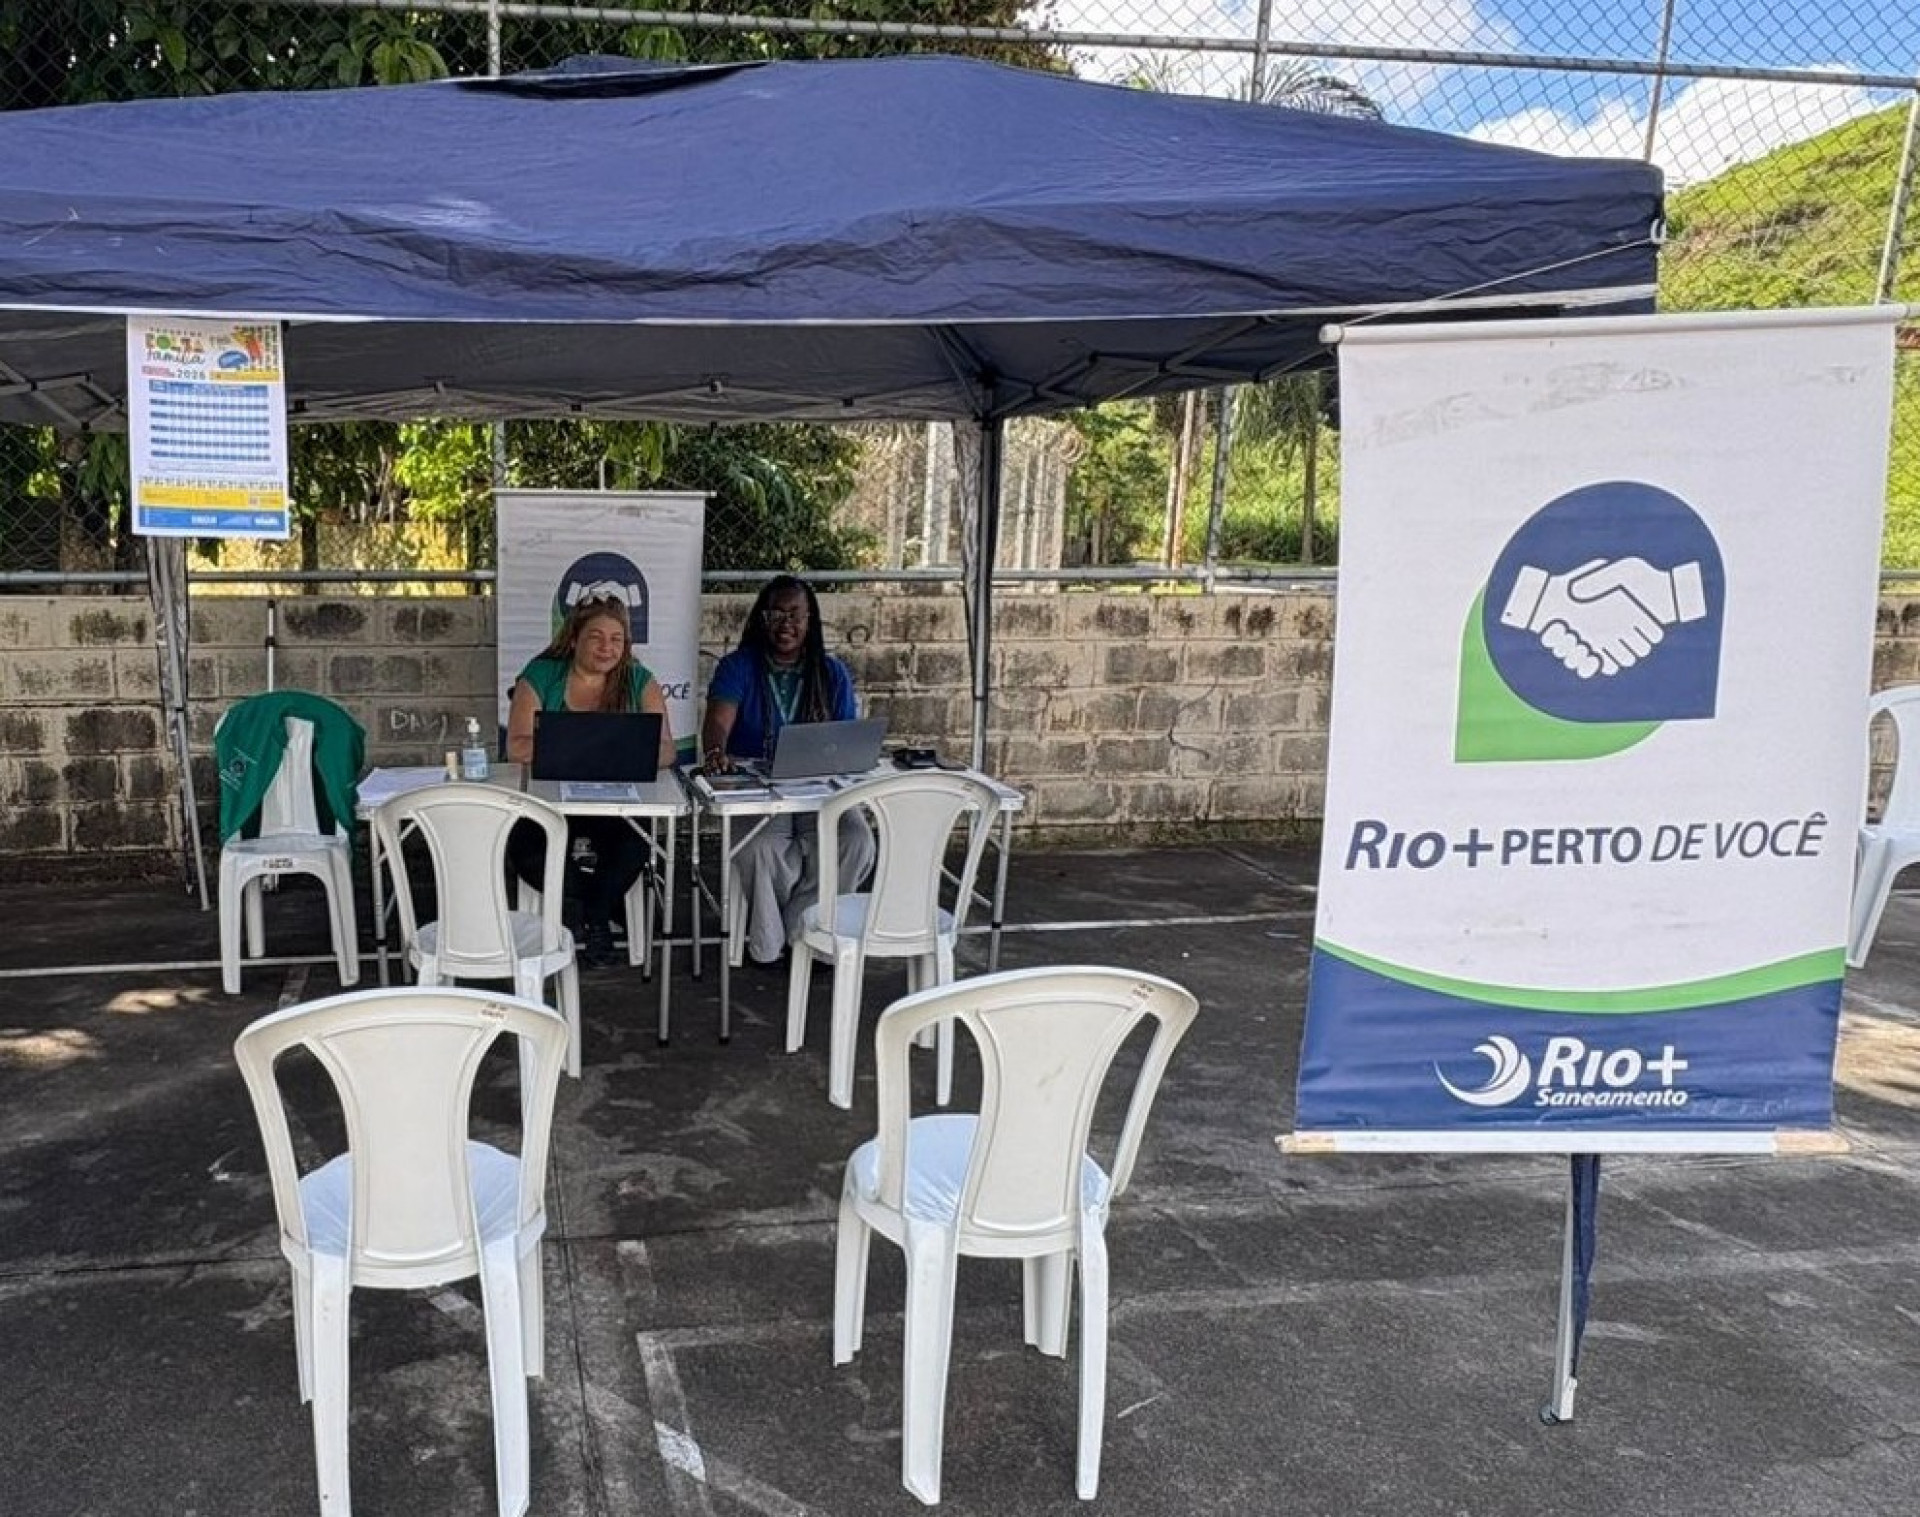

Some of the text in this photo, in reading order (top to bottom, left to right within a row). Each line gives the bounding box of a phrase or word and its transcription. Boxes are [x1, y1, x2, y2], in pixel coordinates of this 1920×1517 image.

[660, 680, 691, 700] OCÊ
[1501, 827, 1642, 866] PERTO
[1650, 824, 1708, 862] DE
[1715, 811, 1828, 859] VOCÊ
[1535, 1088, 1689, 1107] Saneamento
